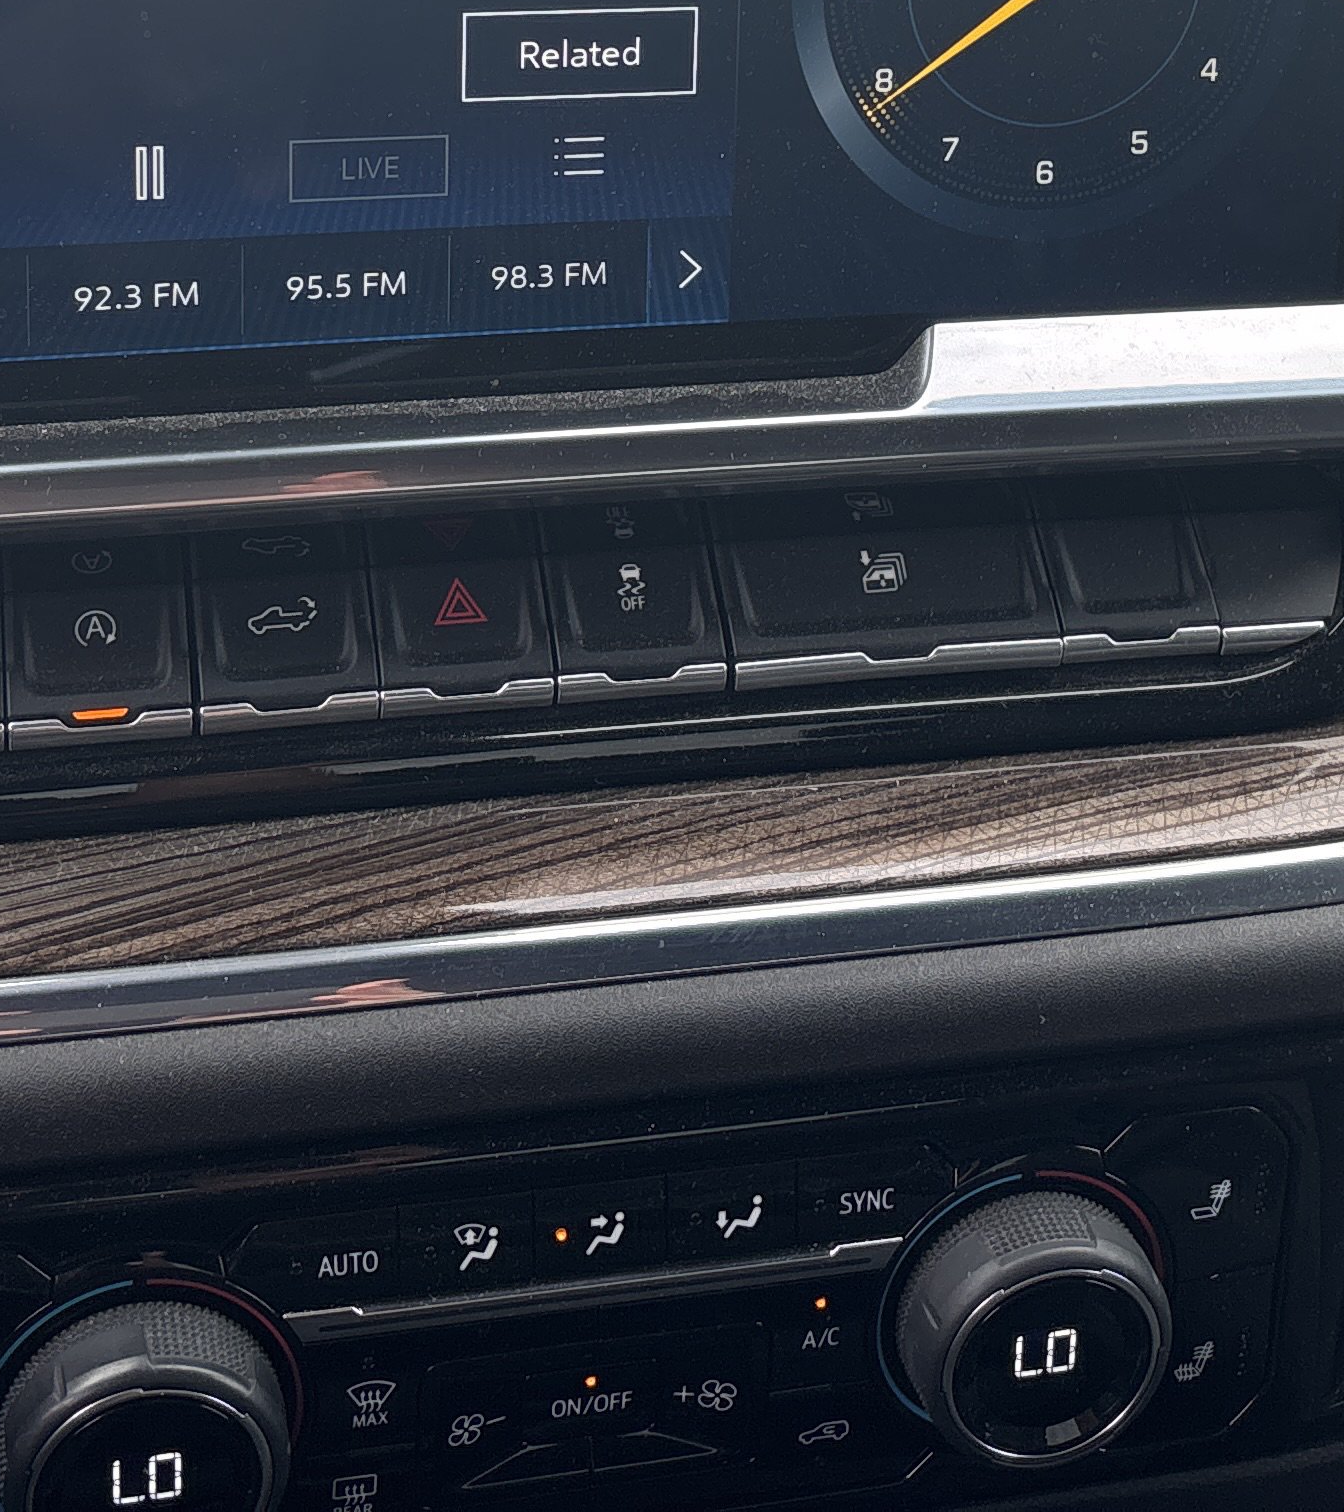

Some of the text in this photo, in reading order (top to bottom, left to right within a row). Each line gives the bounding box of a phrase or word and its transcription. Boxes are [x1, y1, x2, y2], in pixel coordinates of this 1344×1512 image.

[520, 36, 641, 70] Related
[874, 67, 894, 93] 8
[1200, 57, 1219, 82] 4
[942, 136, 960, 162] 7
[1130, 130, 1149, 155] 5
[342, 155, 400, 181] LIVE
[1036, 160, 1054, 185] 6
[286, 270, 406, 301] 95.5 FM
[491, 261, 607, 291] 98.3 FM
[74, 281, 199, 312] 92.3 FM
[620, 595, 646, 612] OFF
[839, 1187, 895, 1215] SYNC
[317, 1250, 379, 1278] AUTO
[801, 1326, 840, 1350] A/C
[1014, 1328, 1077, 1378] LO
[551, 1390, 633, 1418] ON/OFF
[352, 1412, 389, 1428] MAX
[112, 1451, 182, 1505] LO
